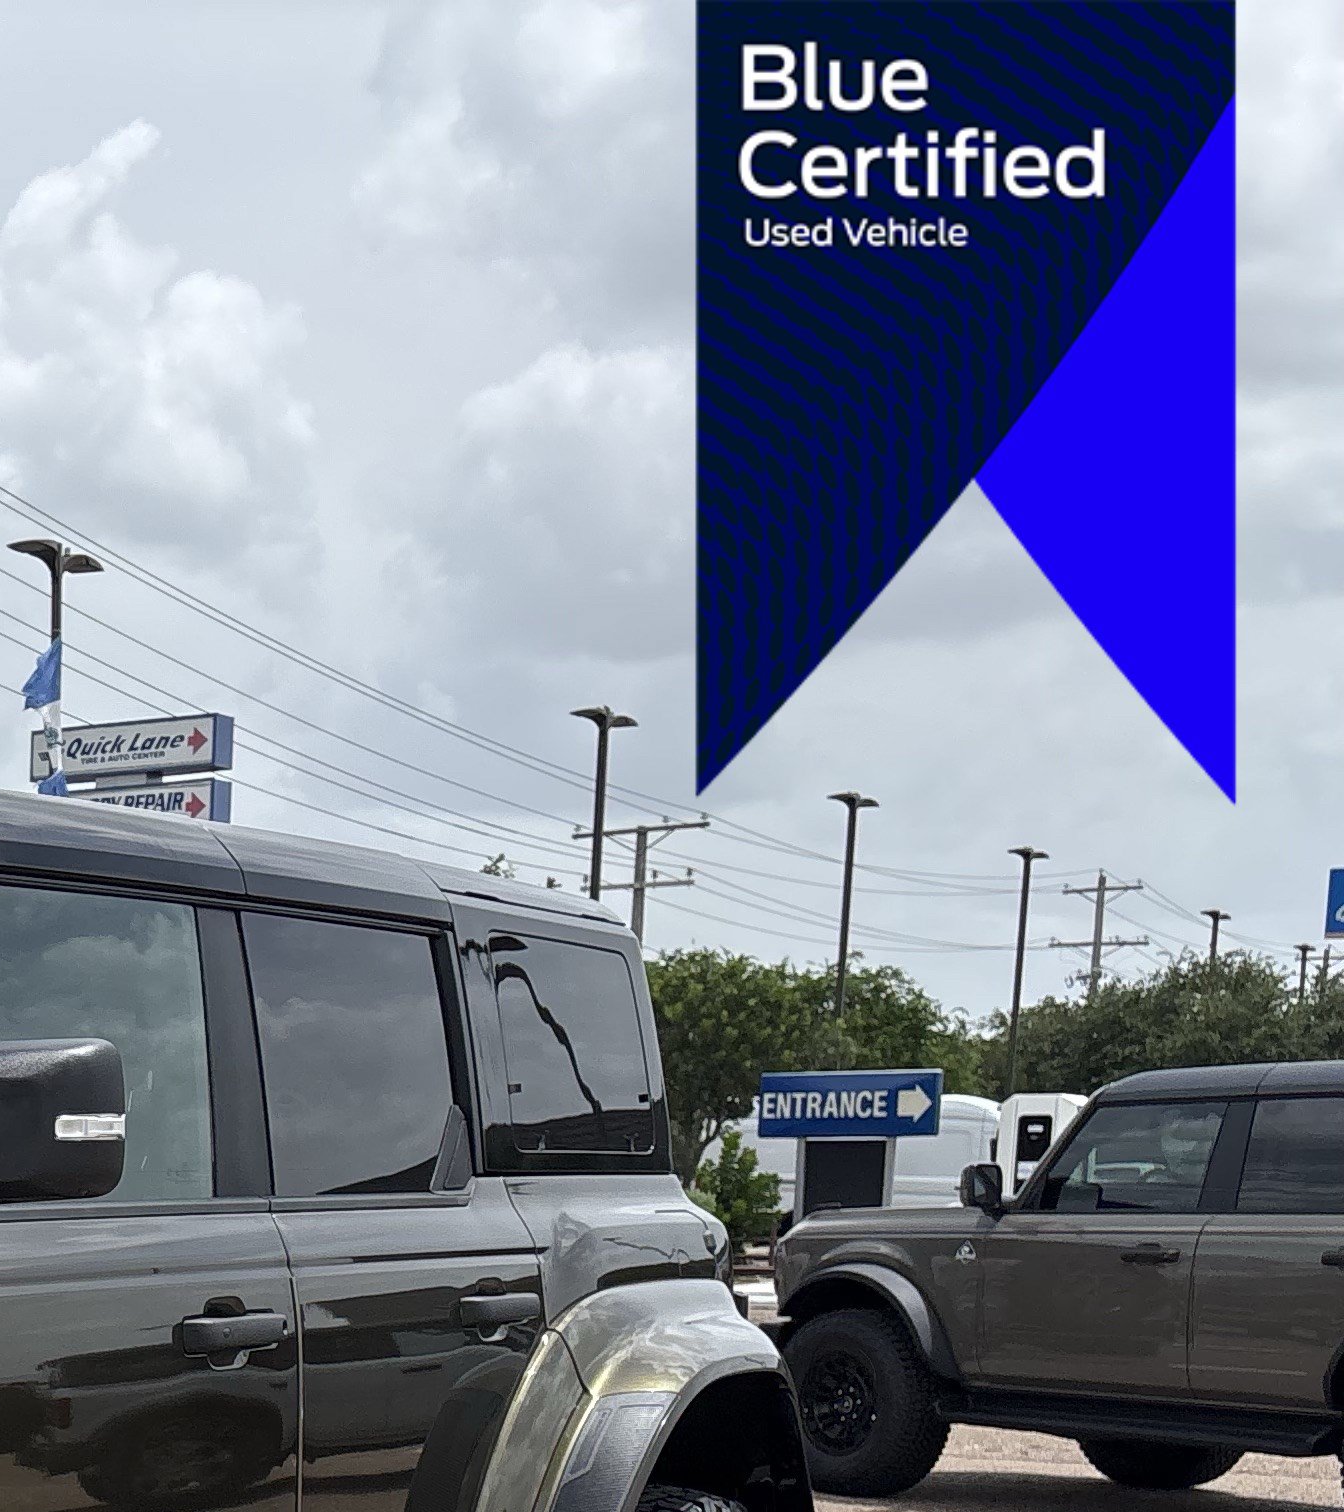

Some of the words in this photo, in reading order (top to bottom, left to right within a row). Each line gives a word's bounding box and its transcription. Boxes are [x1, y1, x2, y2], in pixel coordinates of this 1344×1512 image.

[66, 733, 127, 759] Quick
[127, 732, 185, 752] Lane
[80, 755, 98, 765] TIRE
[108, 753, 130, 762] AUTO
[131, 750, 166, 761] CENTER
[762, 1089, 889, 1120] ENTRANCE
